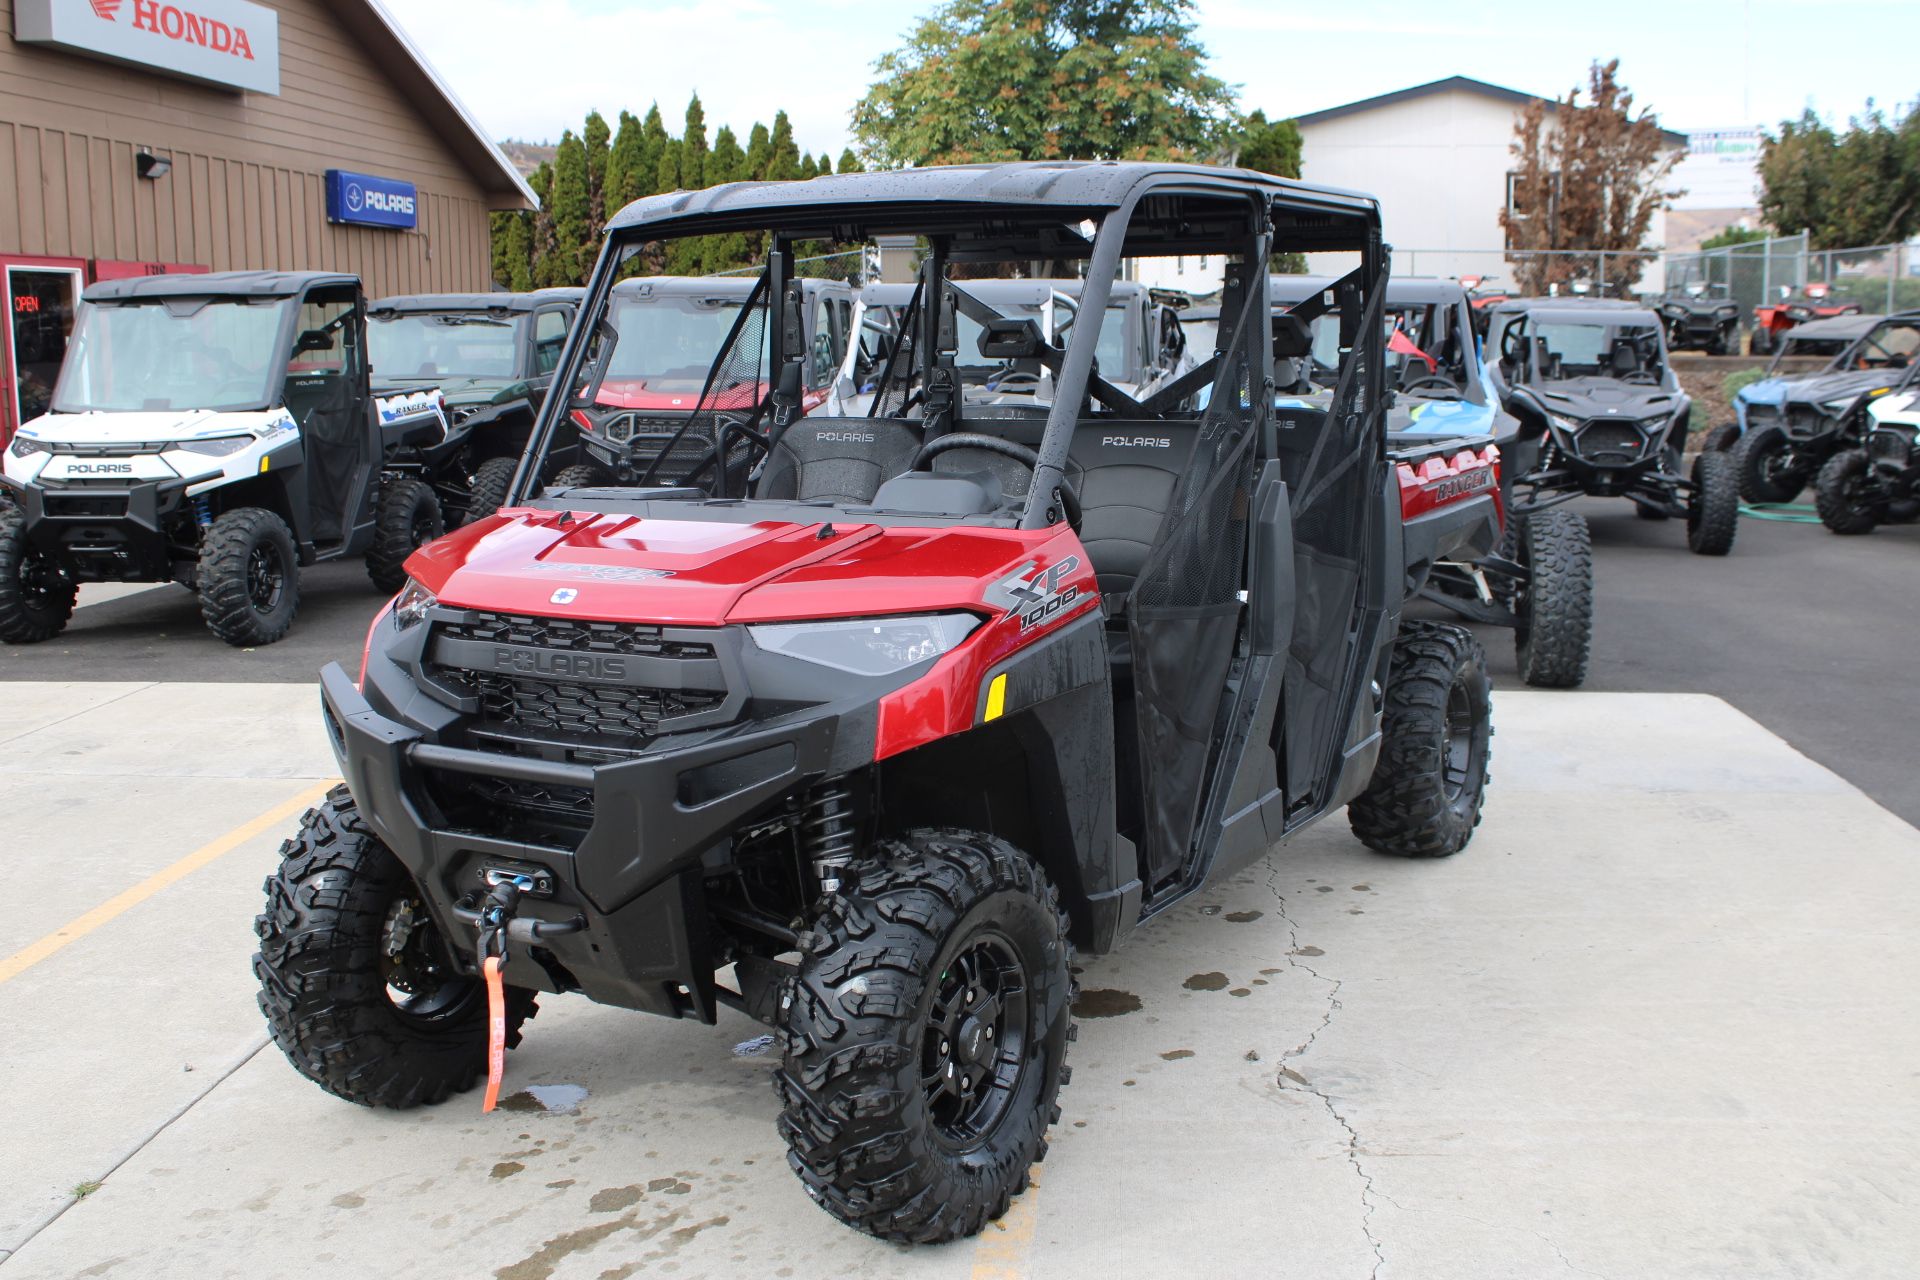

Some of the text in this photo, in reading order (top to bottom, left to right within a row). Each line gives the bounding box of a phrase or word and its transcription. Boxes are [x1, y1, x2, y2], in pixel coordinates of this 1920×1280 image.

[132, 0, 255, 60] HONDA
[365, 190, 414, 214] POLARIS
[15, 296, 39, 312] OPEN
[395, 402, 427, 415] RANGER
[816, 432, 874, 442] POLARIS
[1102, 436, 1171, 448] POLARIS
[67, 464, 132, 473] POLARIS
[1436, 469, 1489, 503] RANGER
[999, 554, 1080, 625] XP
[1020, 584, 1078, 632] 1000
[494, 647, 626, 681] POLARIS
[492, 1017, 505, 1085] POLARIS
